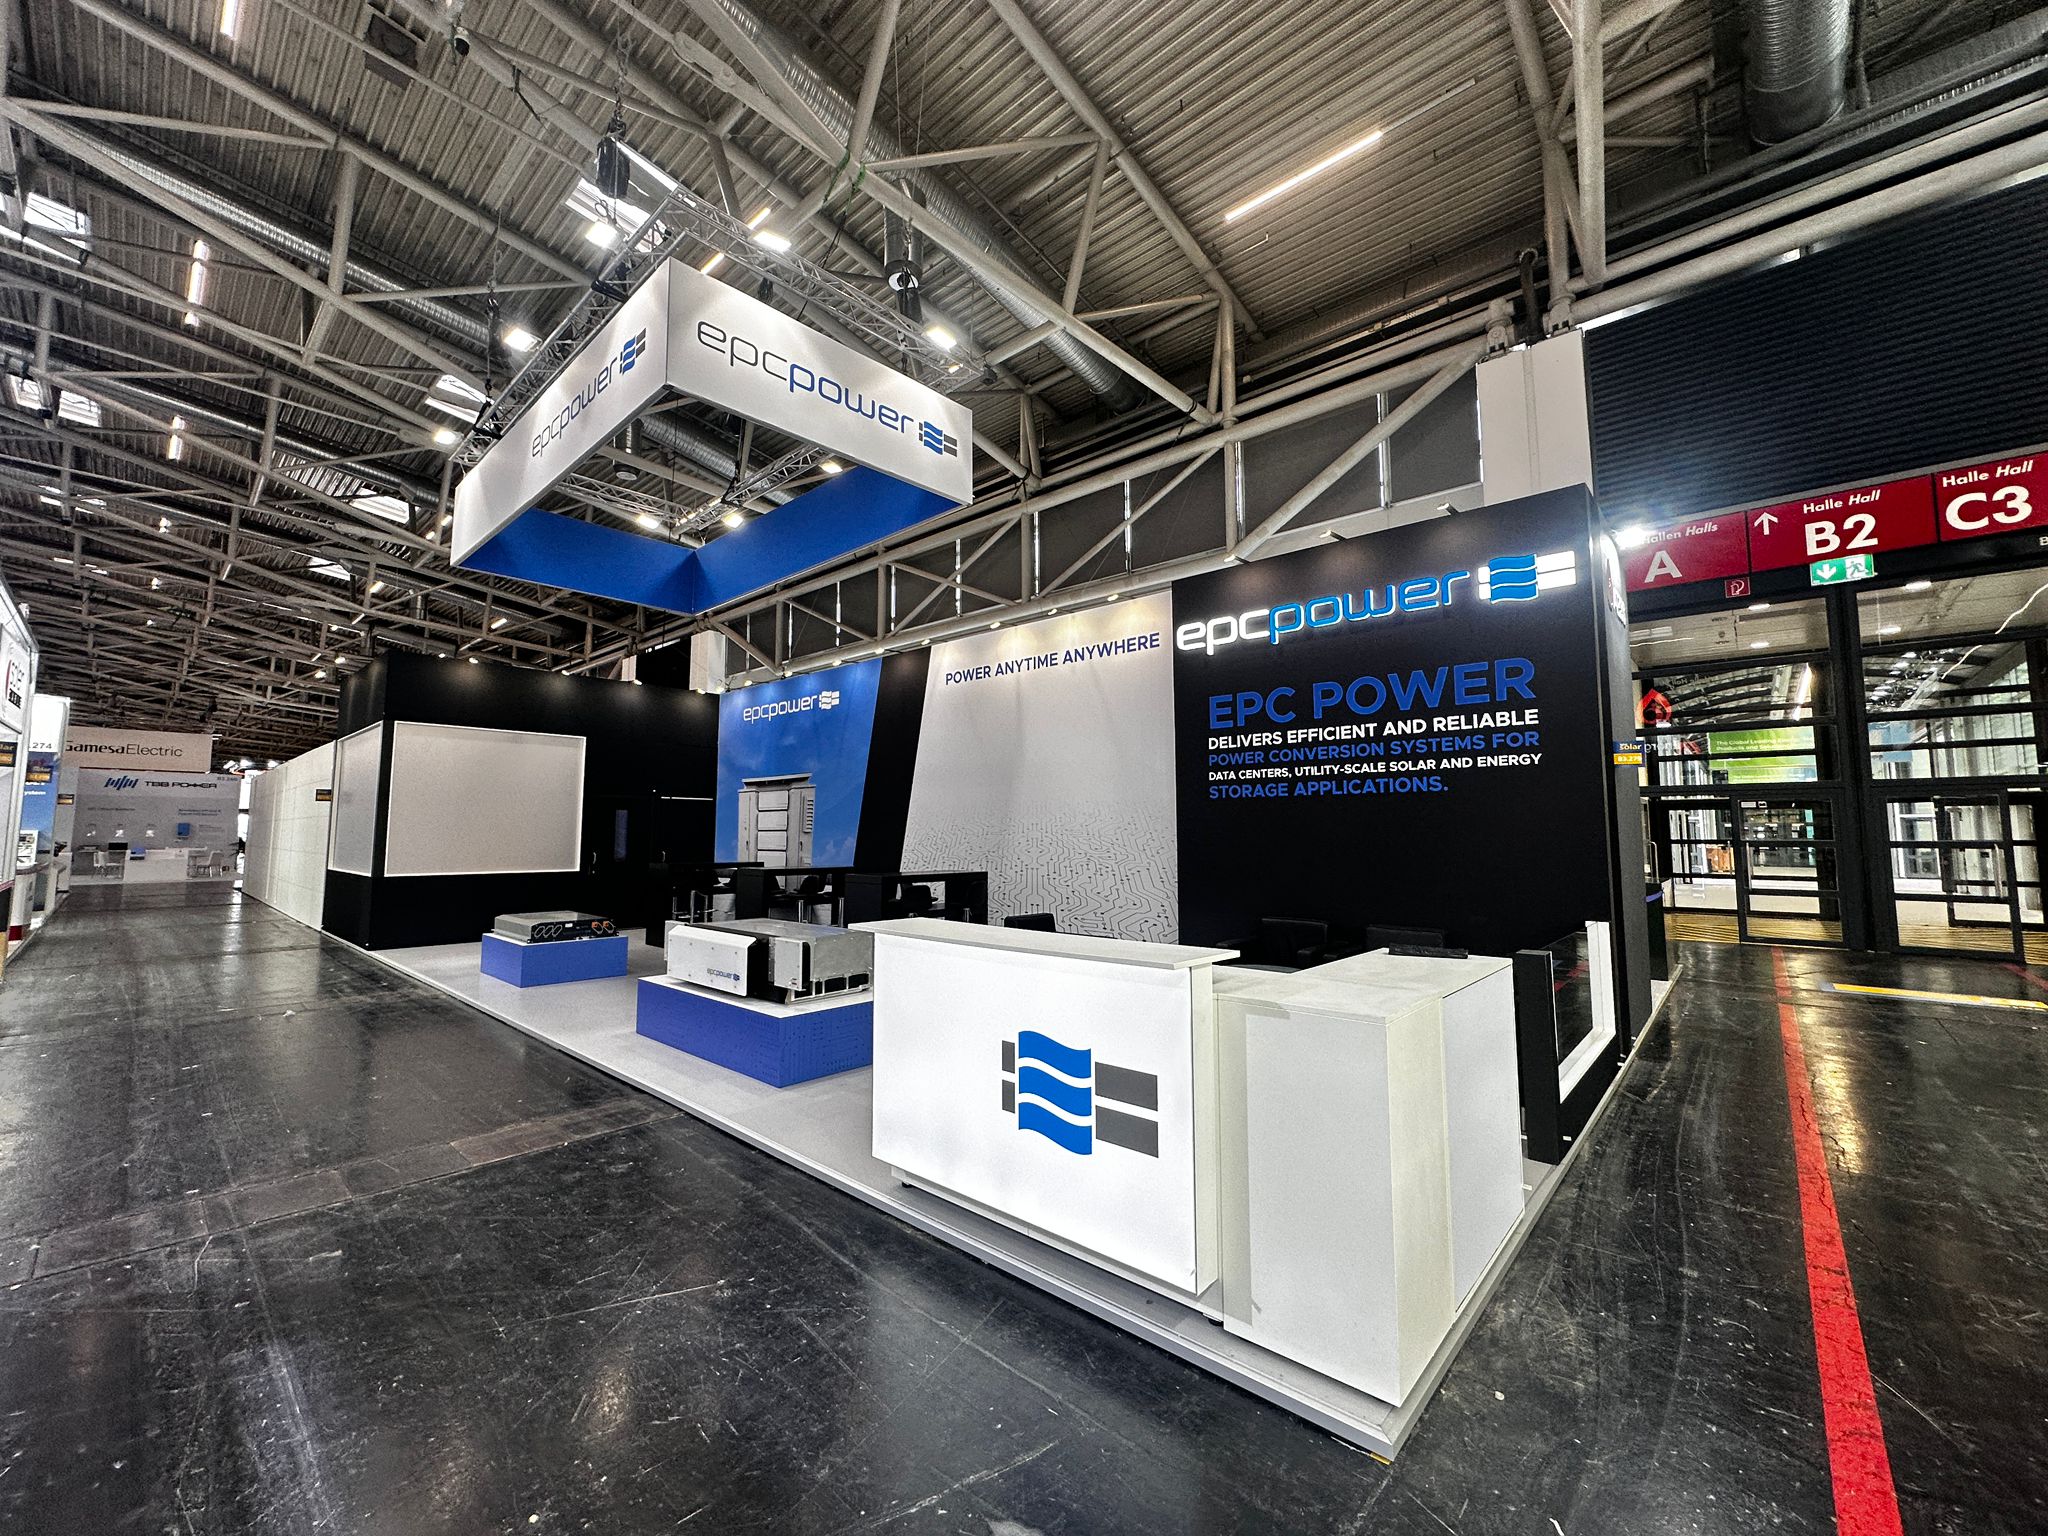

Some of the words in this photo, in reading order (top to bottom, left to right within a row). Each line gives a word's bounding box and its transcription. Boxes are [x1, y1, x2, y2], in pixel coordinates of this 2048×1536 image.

[697, 320, 915, 434] epcpower
[531, 356, 618, 458] epcpower
[1942, 470, 1990, 488] Halle
[1995, 459, 2034, 478] Hall
[1803, 499, 1843, 514] Halle
[1848, 489, 1881, 506] Hall
[1945, 485, 2033, 531] C3
[1685, 522, 1718, 537] Halls
[1804, 513, 1879, 556] B2
[1644, 550, 1683, 583] A
[1176, 570, 1470, 656] epcpower
[945, 664, 992, 686] POWER
[994, 652, 1059, 677] ANYTIME
[1062, 632, 1160, 665] ANYWHERE
[743, 694, 818, 725] epcpower
[1209, 686, 1297, 730] EPC
[1312, 657, 1537, 720] POWER
[1208, 731, 1282, 750] DELIVERS
[1287, 722, 1377, 744] EFFICIENT
[1382, 718, 1427, 736] AND
[1433, 708, 1540, 732] RELIABLE
[1208, 751, 1265, 767] POWER
[1268, 741, 1385, 763] CONVERSION
[1390, 734, 1486, 756] SYSTEMS
[1492, 730, 1540, 749] FOR
[1208, 770, 1237, 781] DATA
[1238, 767, 1293, 779] CENTERS,
[1294, 761, 1387, 777] UTILITY-SCALE
[1389, 759, 1437, 773] SOLAR
[1439, 757, 1473, 770] AND
[1477, 752, 1543, 768] ENERGY
[1209, 782, 1289, 799] STORAGE
[1294, 775, 1450, 797] APPLICATIONS.
